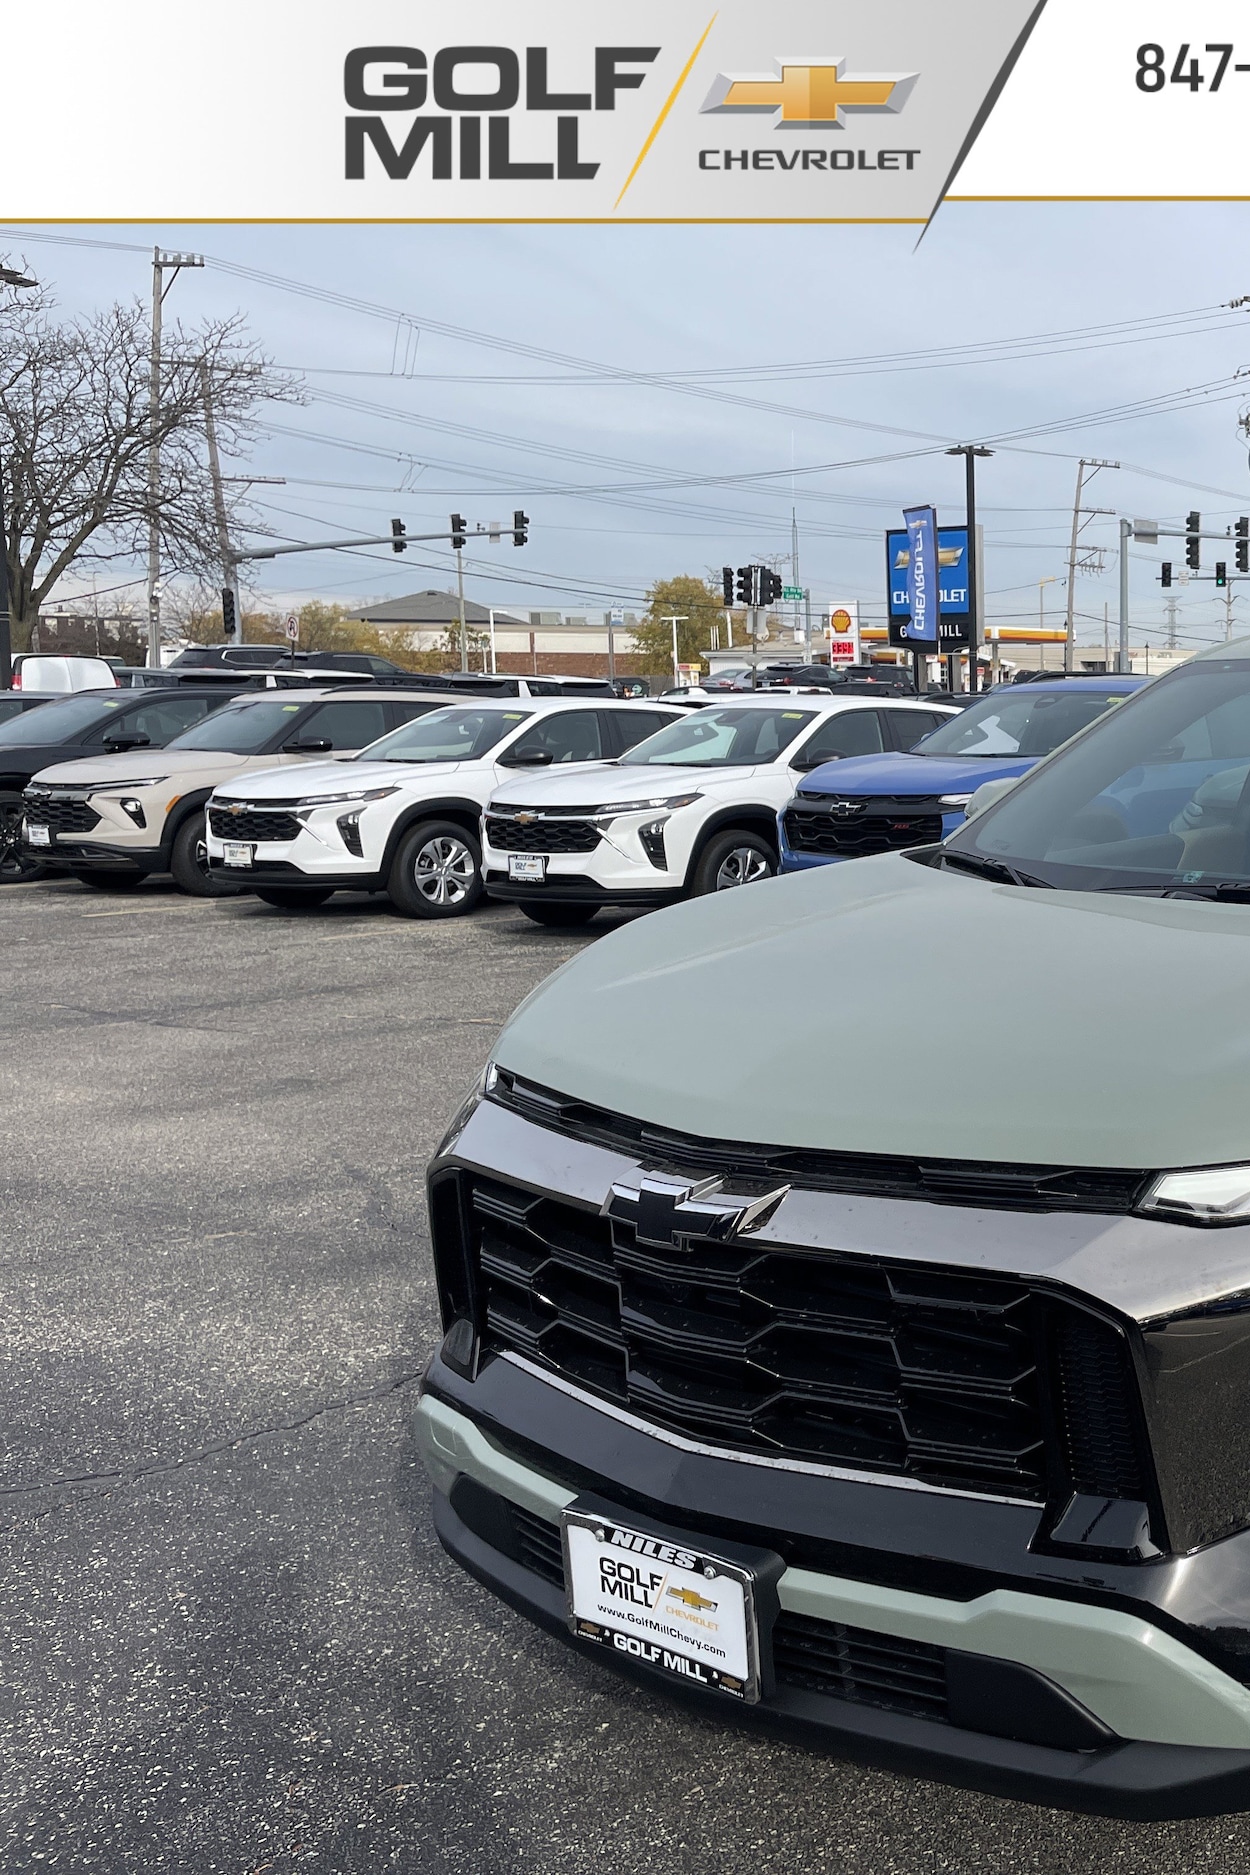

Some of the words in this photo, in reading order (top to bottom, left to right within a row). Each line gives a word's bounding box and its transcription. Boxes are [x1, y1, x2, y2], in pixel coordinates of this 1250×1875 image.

[611, 1529, 697, 1570] NILES
[599, 1556, 664, 1591] GOLF
[600, 1575, 653, 1609] MILL
[597, 1603, 727, 1659] www.GolfMillChevy.com
[665, 1605, 720, 1632] CHEVROLET
[613, 1632, 662, 1663] GOLF
[663, 1651, 708, 1684] MILL
